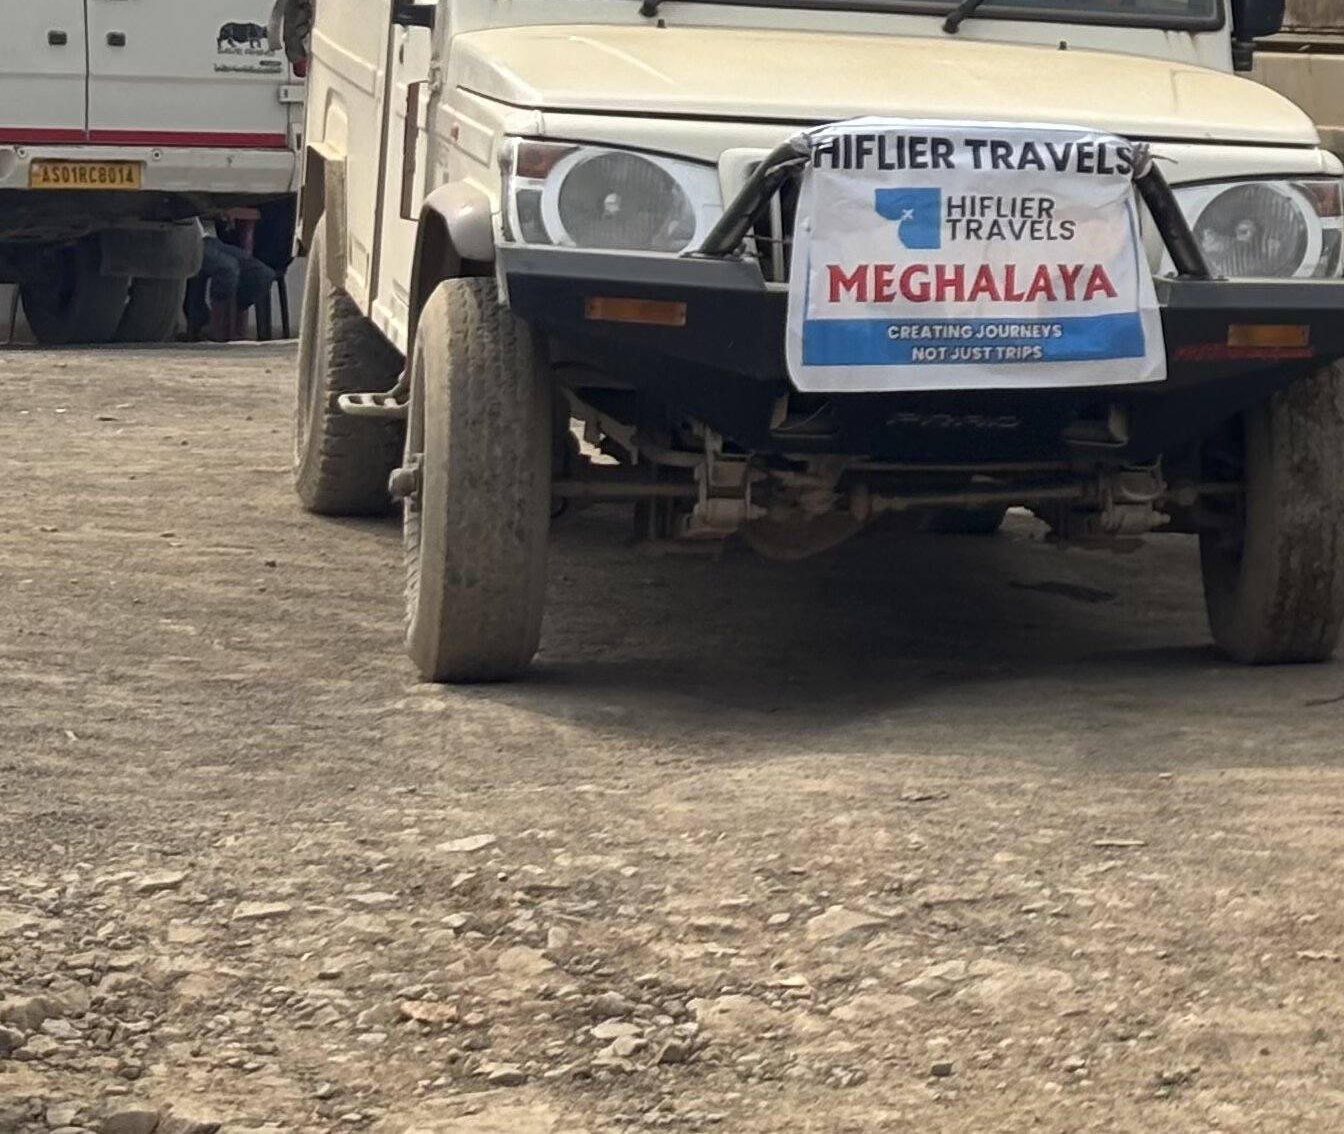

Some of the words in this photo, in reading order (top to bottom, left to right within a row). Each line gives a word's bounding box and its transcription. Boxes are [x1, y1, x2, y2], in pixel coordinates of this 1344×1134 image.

[813, 134, 955, 170] HIFLIER
[964, 138, 1134, 175] TRAVELS
[947, 196, 1055, 219] HIFLIER
[946, 219, 1076, 241] TRAVELS
[826, 264, 1118, 303] MEGHALAYA
[887, 324, 973, 339] CREATING
[976, 323, 1063, 339] JOURNEYS
[912, 347, 948, 361] NOT
[950, 346, 992, 361] JUST
[996, 346, 1042, 360] TRIPS
